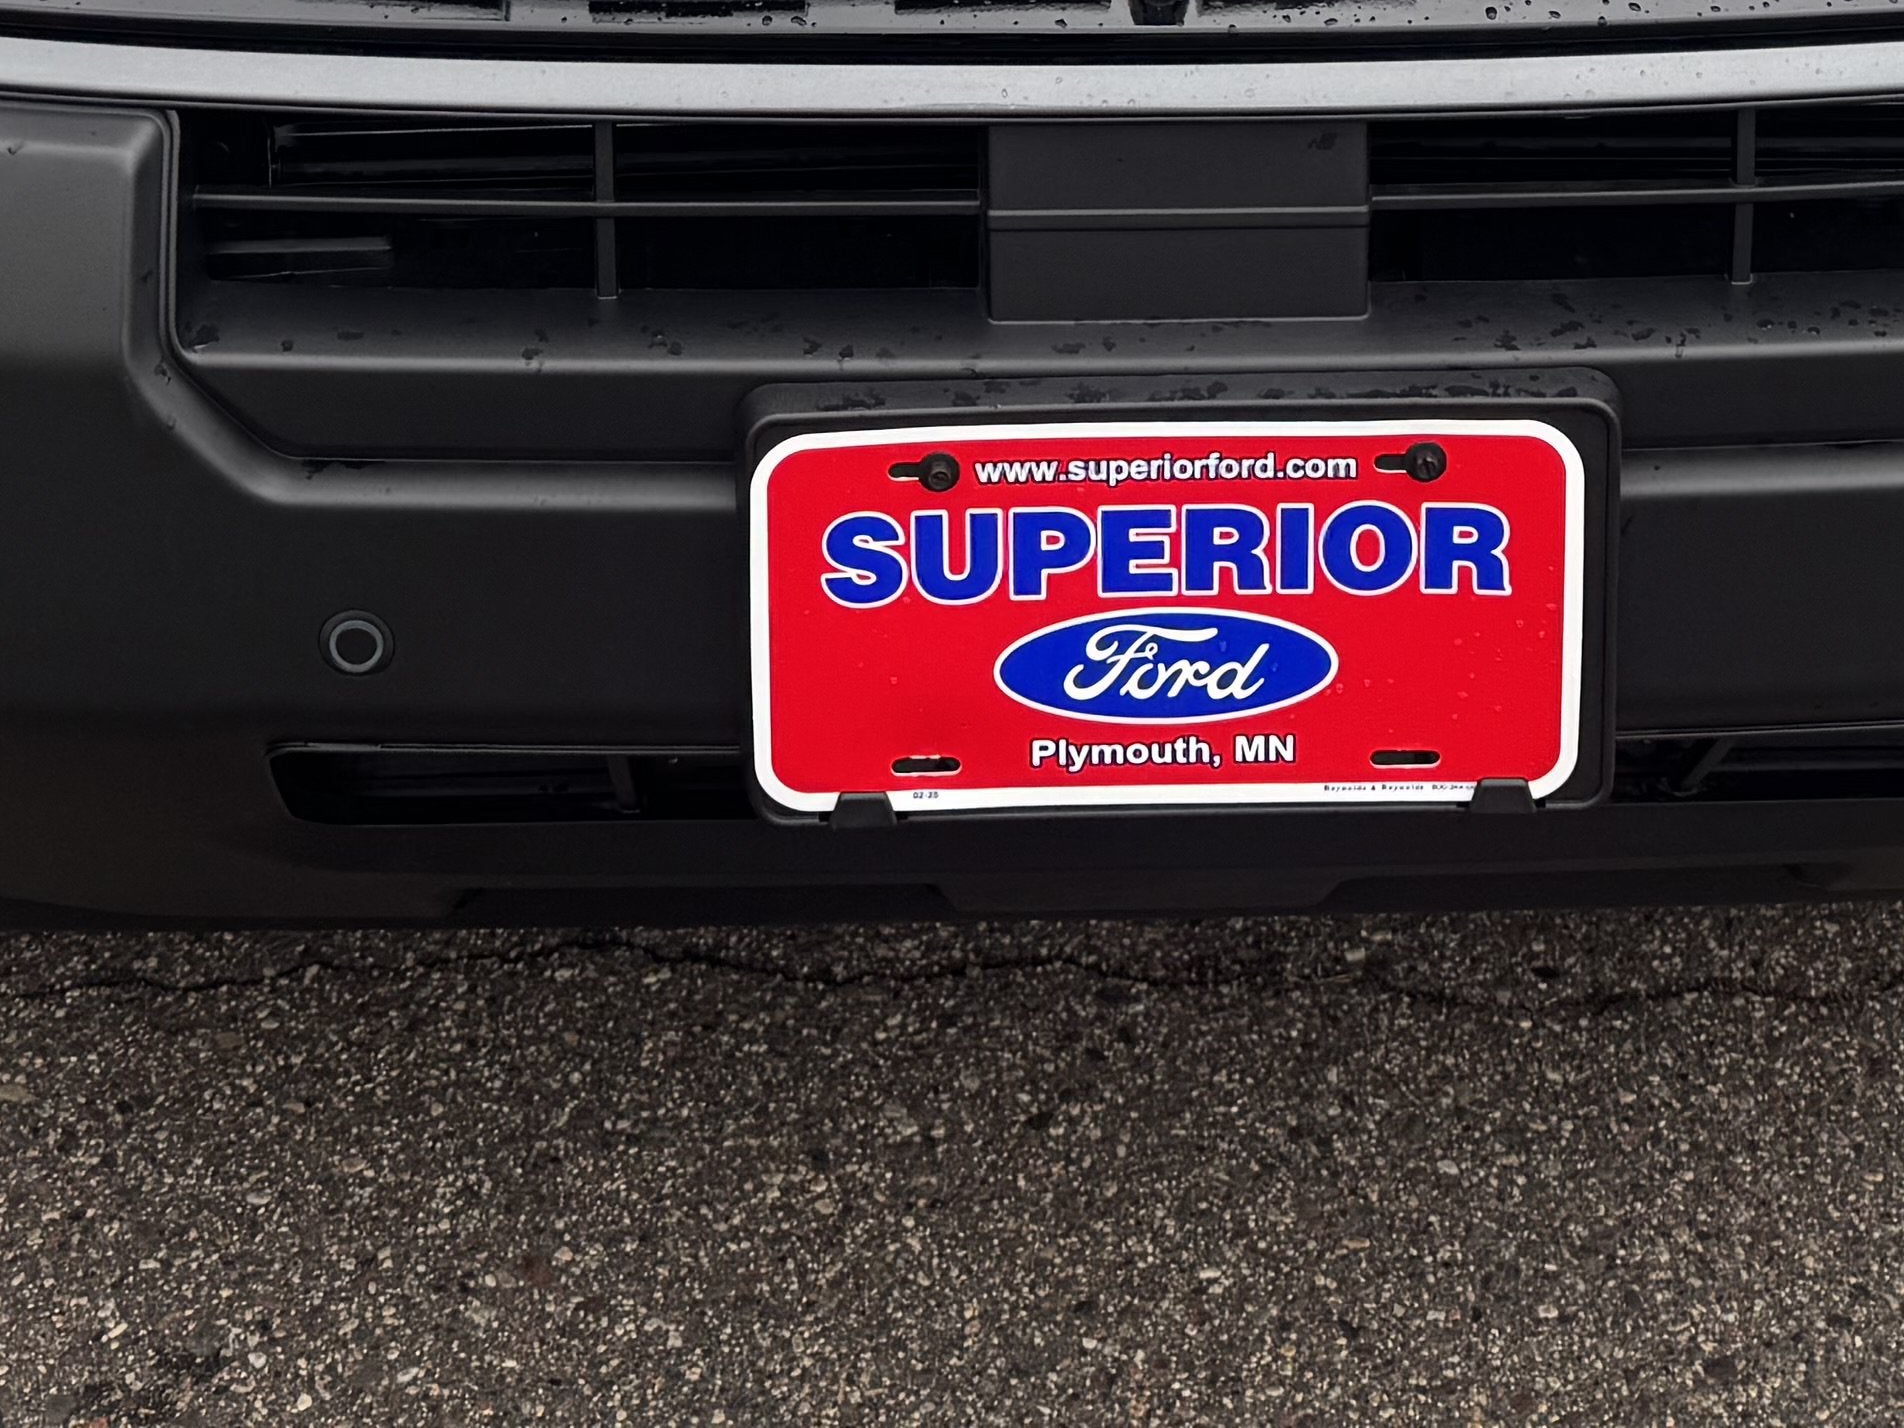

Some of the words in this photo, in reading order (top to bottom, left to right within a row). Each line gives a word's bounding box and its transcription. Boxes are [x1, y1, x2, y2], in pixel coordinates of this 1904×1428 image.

[975, 452, 1357, 486] www.superiorford.com
[821, 500, 1512, 608] SUPERIOR
[1063, 624, 1269, 701] Ford
[1032, 736, 1221, 773] Plymouth,
[1235, 735, 1295, 763] MN
